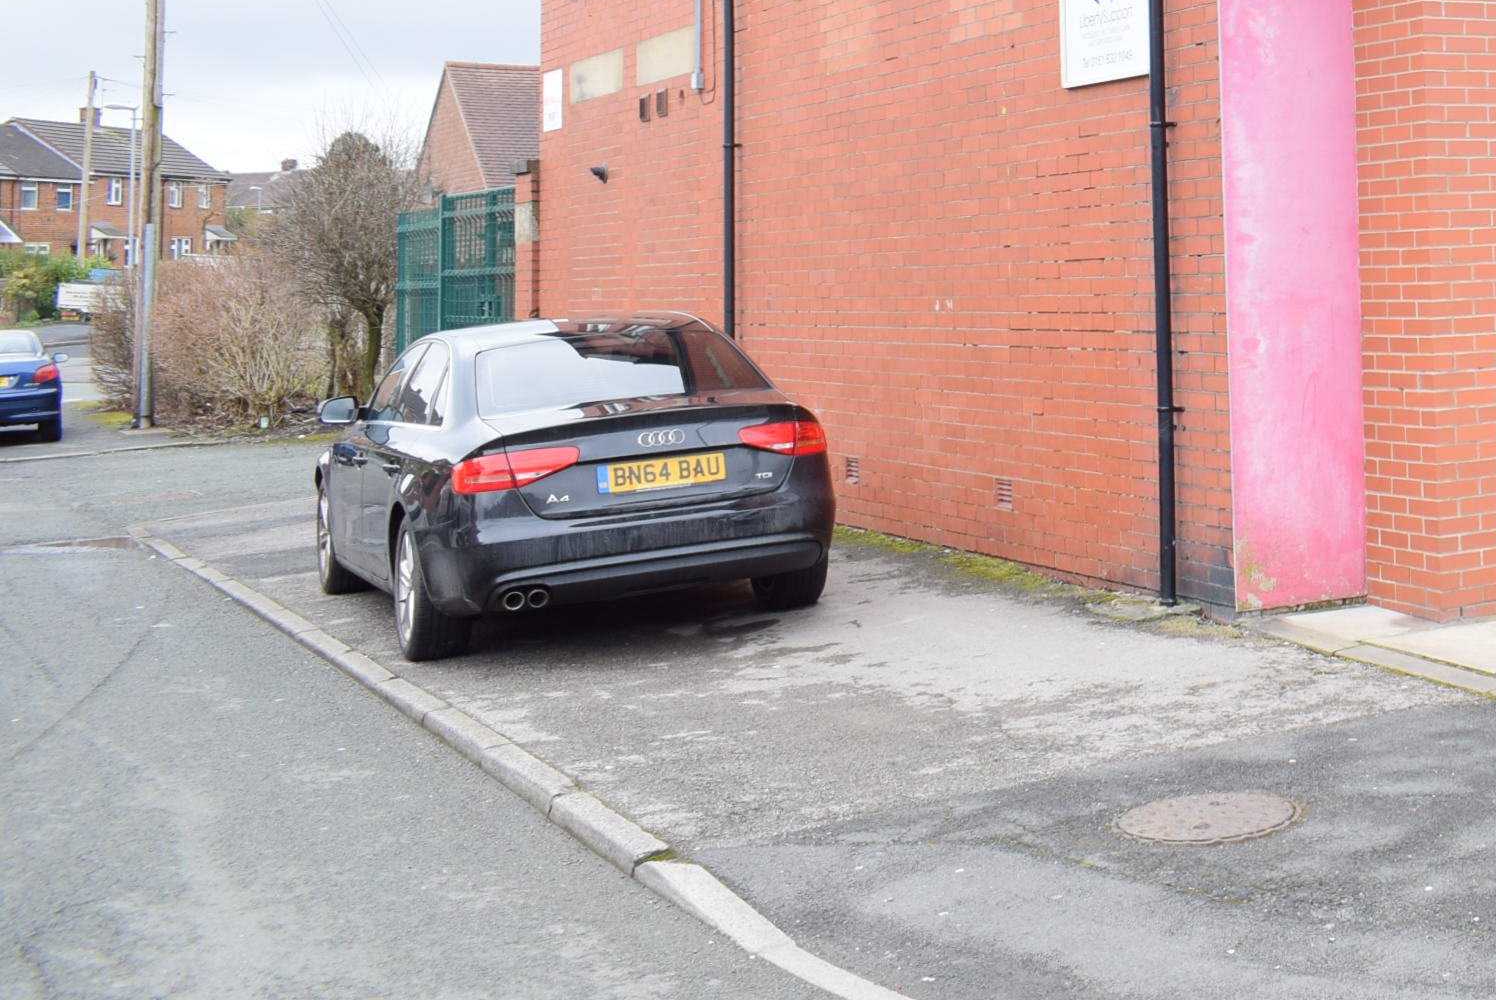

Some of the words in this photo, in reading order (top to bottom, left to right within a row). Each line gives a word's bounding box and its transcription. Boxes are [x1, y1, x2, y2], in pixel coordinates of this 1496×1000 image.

[613, 461, 671, 487] BN64
[678, 456, 720, 480] BAU
[545, 493, 571, 504] A4
